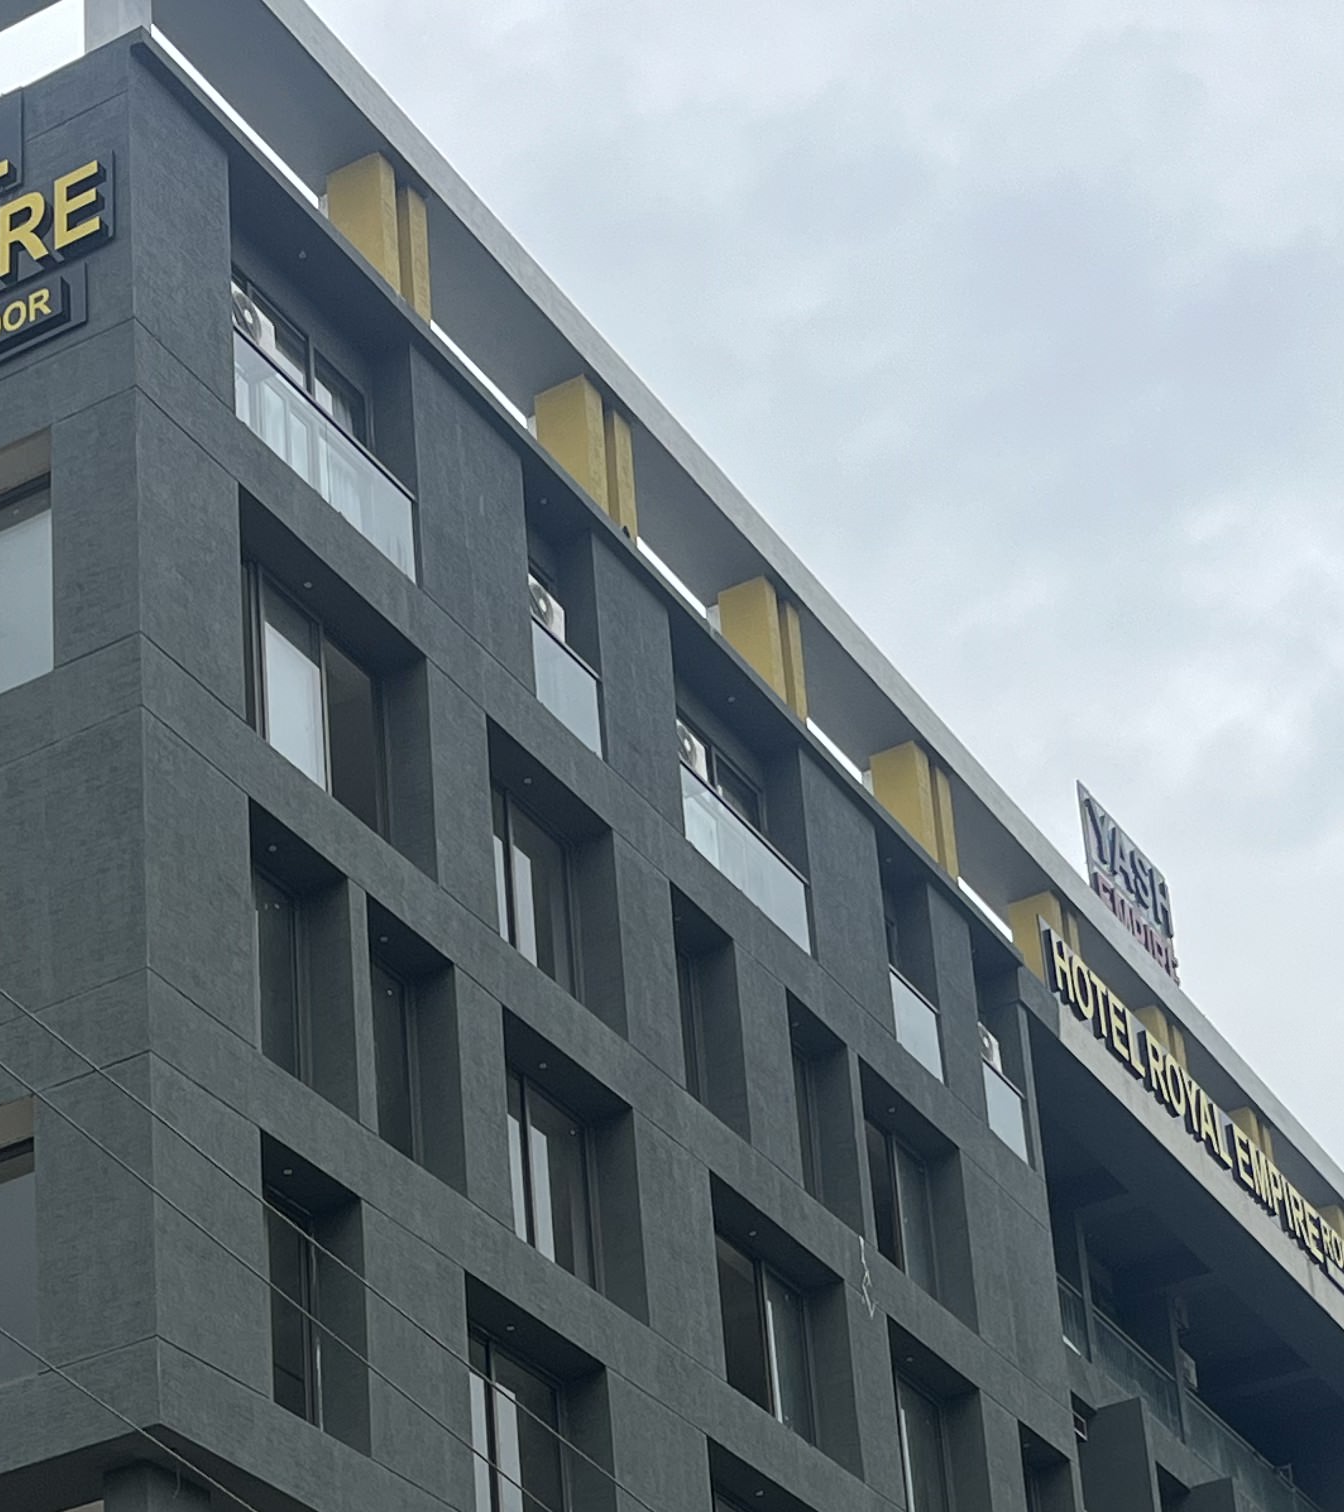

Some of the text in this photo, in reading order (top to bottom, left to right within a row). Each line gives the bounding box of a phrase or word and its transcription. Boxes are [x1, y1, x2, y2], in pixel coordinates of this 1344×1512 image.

[1084, 798, 1174, 939] YASH
[1047, 929, 1146, 1080] HOTEL
[1141, 1029, 1234, 1169] ROYAL
[1230, 1122, 1325, 1264] EMPIRE
